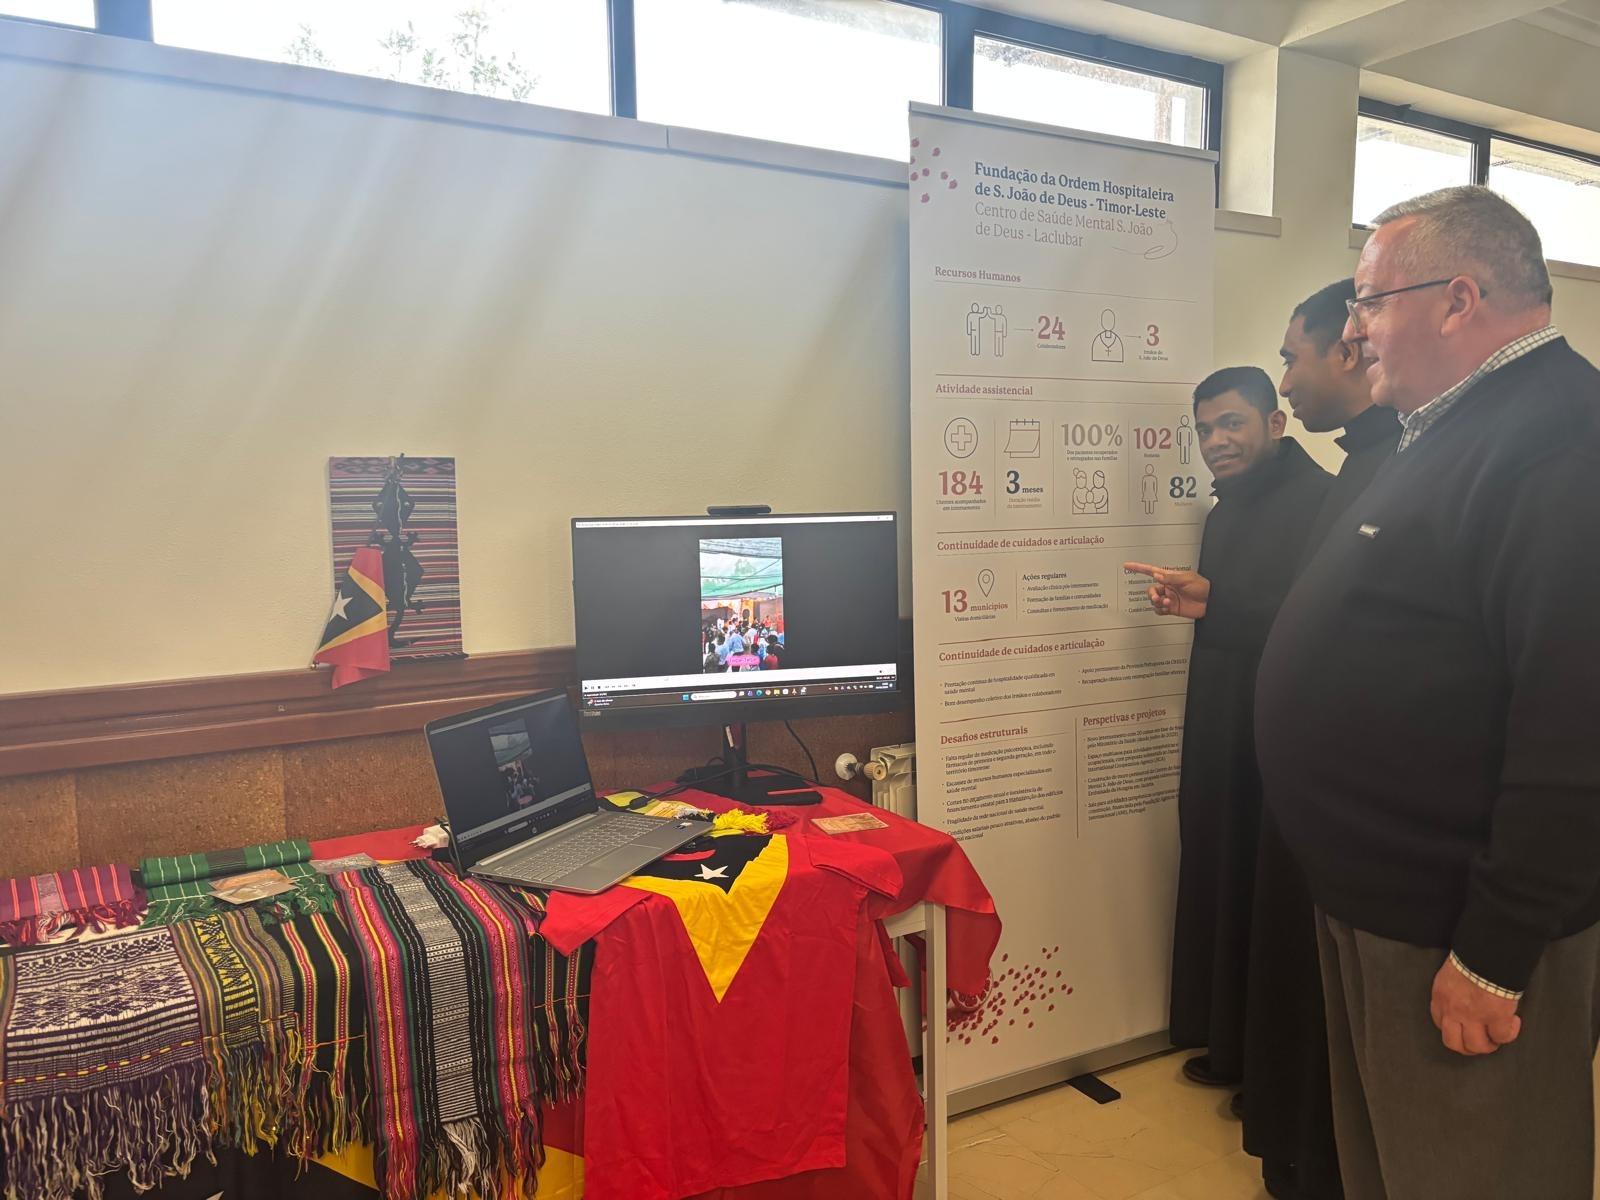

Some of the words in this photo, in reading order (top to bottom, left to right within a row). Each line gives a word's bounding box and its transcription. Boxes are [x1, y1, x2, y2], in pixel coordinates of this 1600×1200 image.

[975, 162, 1038, 184] Fundação
[1040, 172, 1055, 186] da
[1059, 174, 1100, 192] Ordem
[1103, 180, 1174, 202] Hospitaleira
[975, 182, 990, 196] de
[993, 185, 1004, 198] S.
[1007, 186, 1036, 202] João
[1040, 191, 1054, 204] de
[1058, 193, 1087, 208] Deus
[1096, 198, 1166, 218] Timor-Leste
[975, 202, 1017, 219] Centro
[1020, 207, 1034, 221] de
[1038, 209, 1072, 226] Saúde
[1076, 214, 1114, 231] Mental
[1117, 220, 1126, 233] S.
[1128, 221, 1153, 236] João
[976, 222, 990, 236] de
[994, 224, 1024, 240] Deus
[1035, 229, 1083, 247] Laclubar
[935, 266, 976, 279] Recursos
[979, 270, 1021, 282] Humanos
[1038, 316, 1065, 340] 24
[1146, 324, 1160, 346] 3
[936, 384, 981, 394] Atividade
[982, 385, 1033, 395] assistencial
[1061, 424, 1122, 446] 100%
[1133, 428, 1171, 450] 102
[939, 471, 983, 495] 184
[1006, 470, 1020, 494] 3
[1169, 476, 1197, 498] 82
[937, 539, 999, 551] Continuidade
[1000, 539, 1011, 548] de
[1012, 537, 1051, 548] cuidados
[1059, 535, 1104, 546] articulação
[942, 589, 967, 614] 13
[970, 602, 1008, 612] municípios
[939, 647, 1000, 661] Continuidade
[1002, 647, 1012, 655] de
[1014, 644, 1053, 654] cuidados
[1060, 638, 1104, 651] articulação
[1083, 713, 1130, 726] Perspetivas
[1136, 708, 1166, 721] projetos
[940, 732, 978, 744] Desafios
[980, 726, 1028, 740] estruturais
